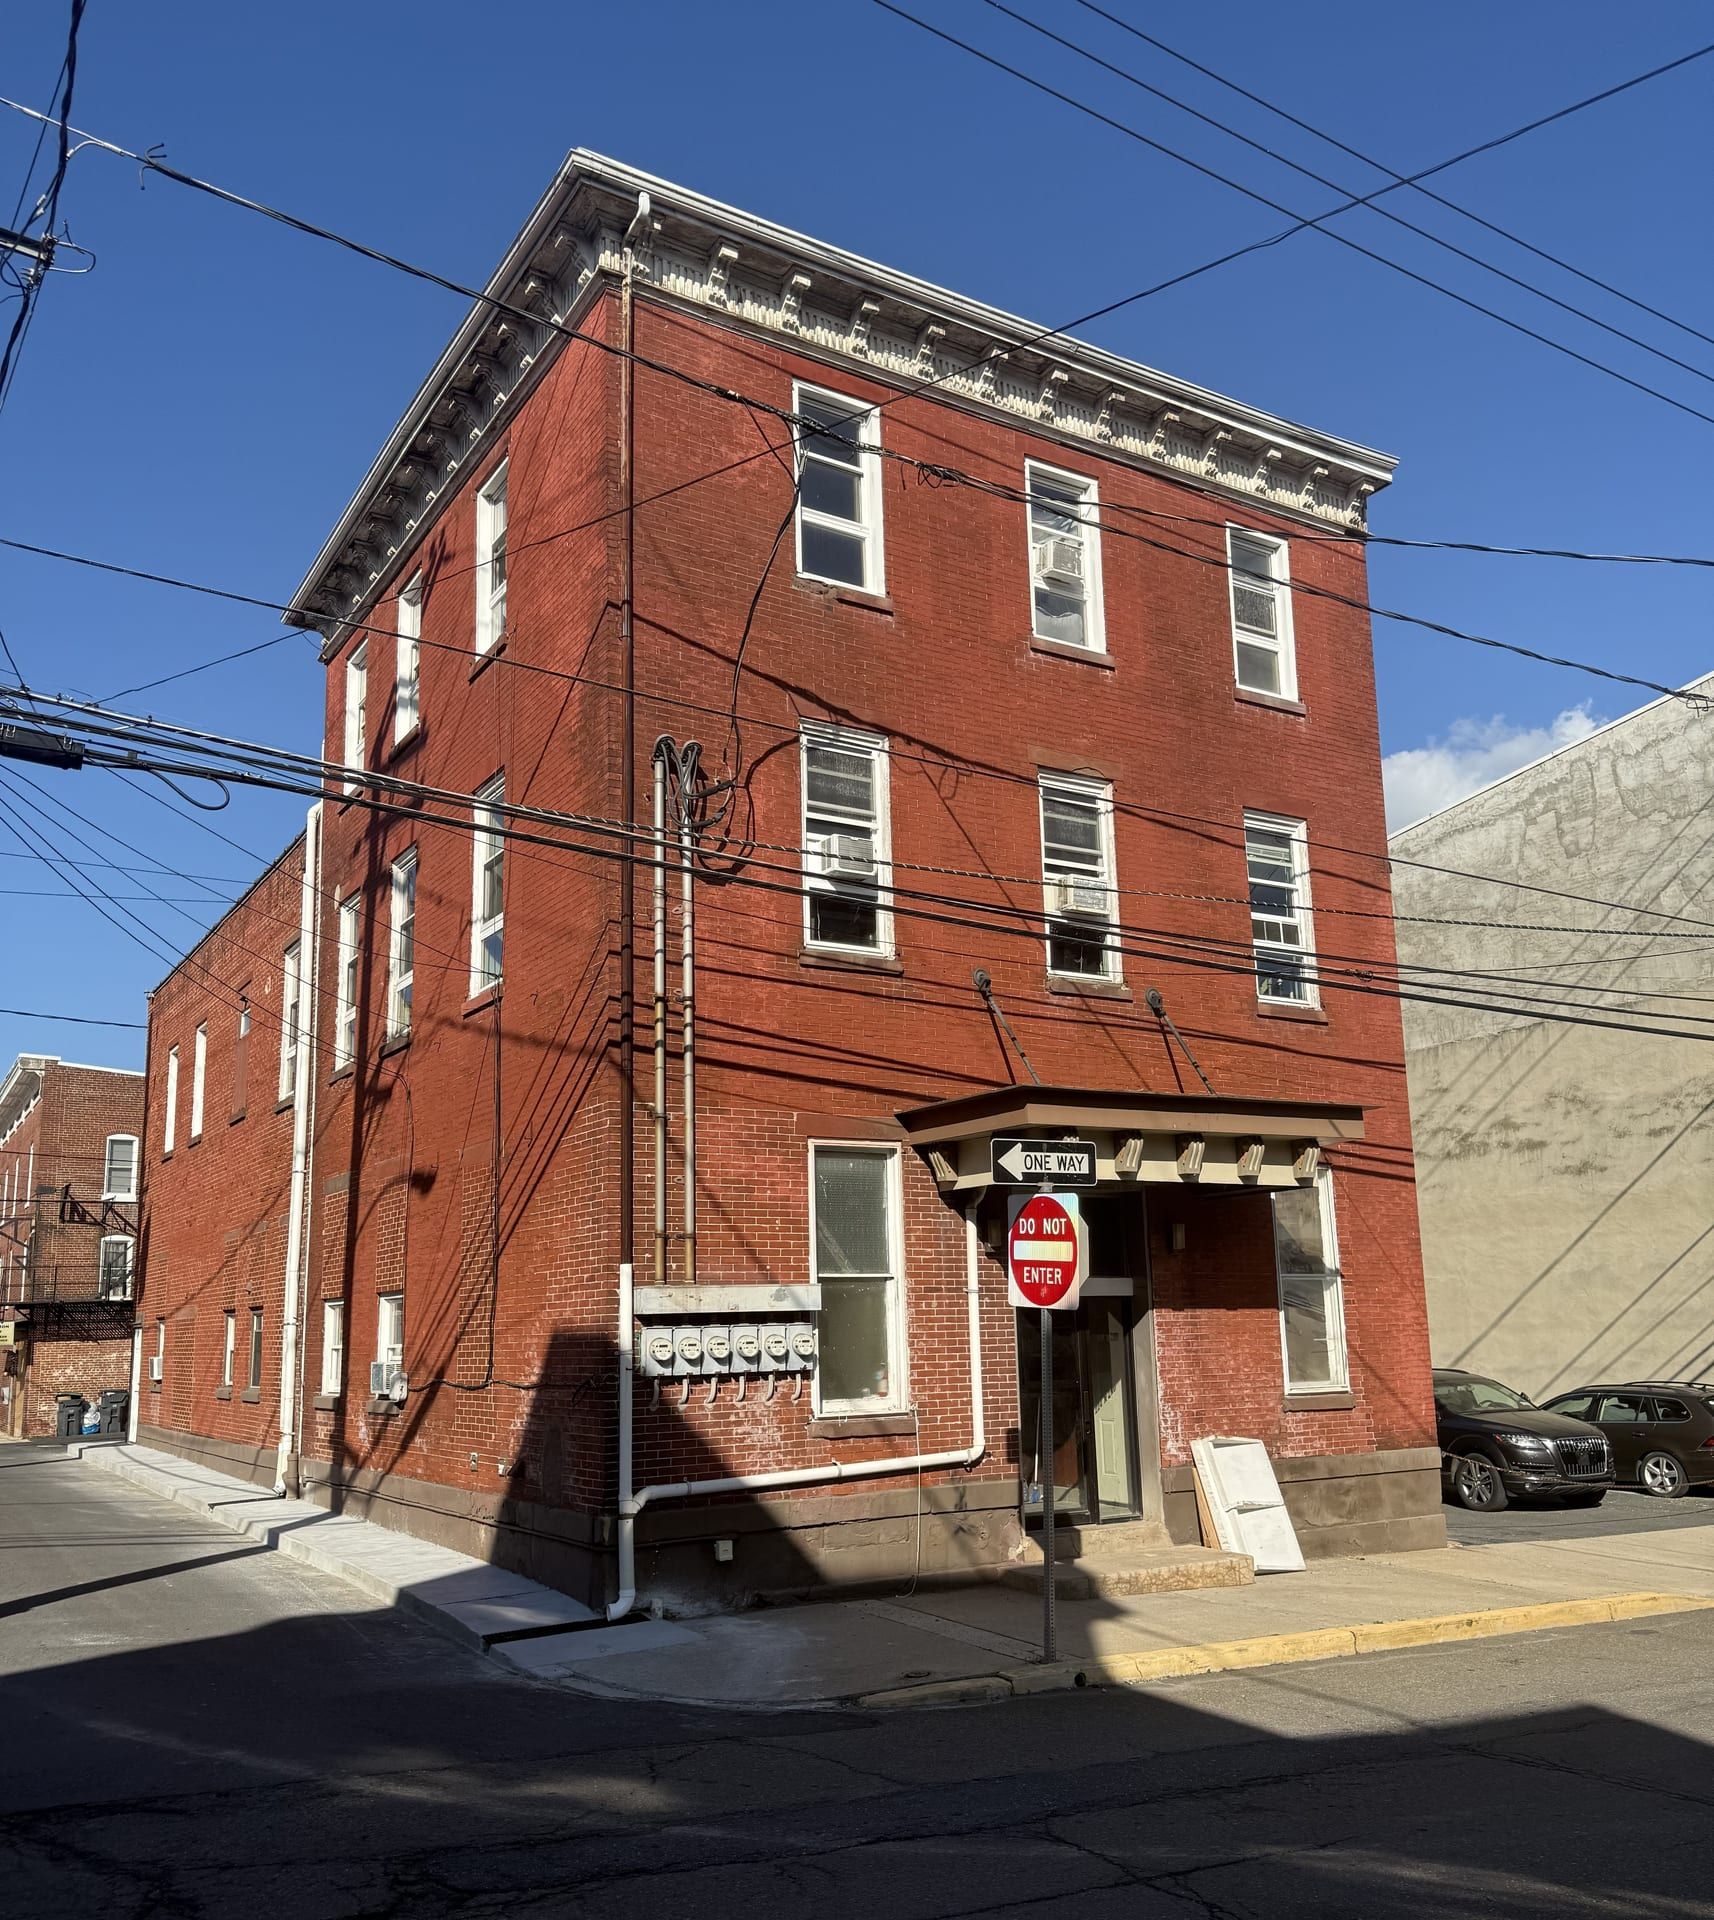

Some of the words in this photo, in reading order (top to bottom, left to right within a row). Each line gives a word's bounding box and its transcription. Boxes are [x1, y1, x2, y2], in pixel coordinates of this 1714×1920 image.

[1024, 1154, 1052, 1171] ONE
[1056, 1155, 1085, 1172] WAY
[1019, 1218, 1035, 1235] DO
[1042, 1218, 1067, 1235] NOT
[1023, 1266, 1062, 1285] ENTER
